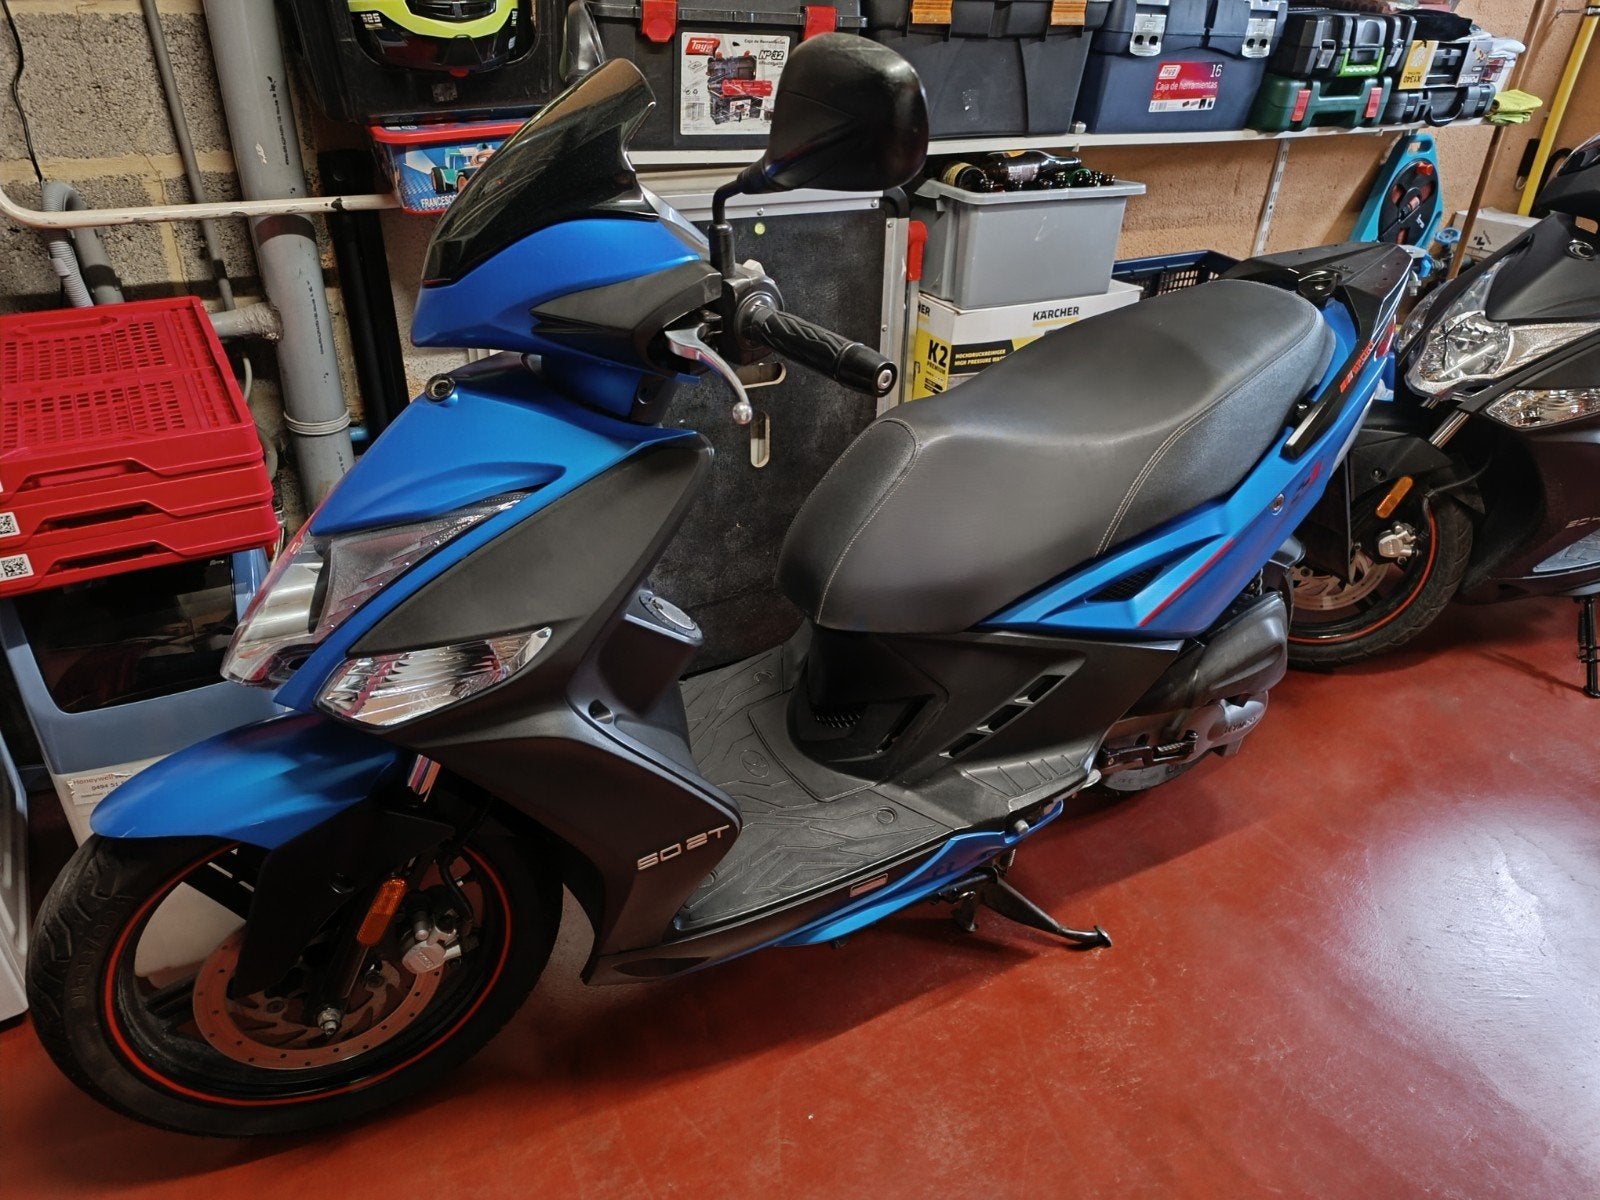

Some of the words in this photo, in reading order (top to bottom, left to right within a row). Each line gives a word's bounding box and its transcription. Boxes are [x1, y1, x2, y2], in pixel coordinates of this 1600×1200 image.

[771, 50, 785, 60] 32
[1210, 64, 1223, 78] 16
[1155, 81, 1170, 92] Caja
[1170, 81, 1178, 90] de
[1179, 79, 1218, 90] herramientas
[1032, 306, 1079, 321] KÄRCHER
[928, 339, 948, 367] K2
[955, 348, 1006, 359] HOCHDRUCKREINIGER
[967, 357, 992, 365] PRESSURE
[686, 824, 730, 851] 2T
